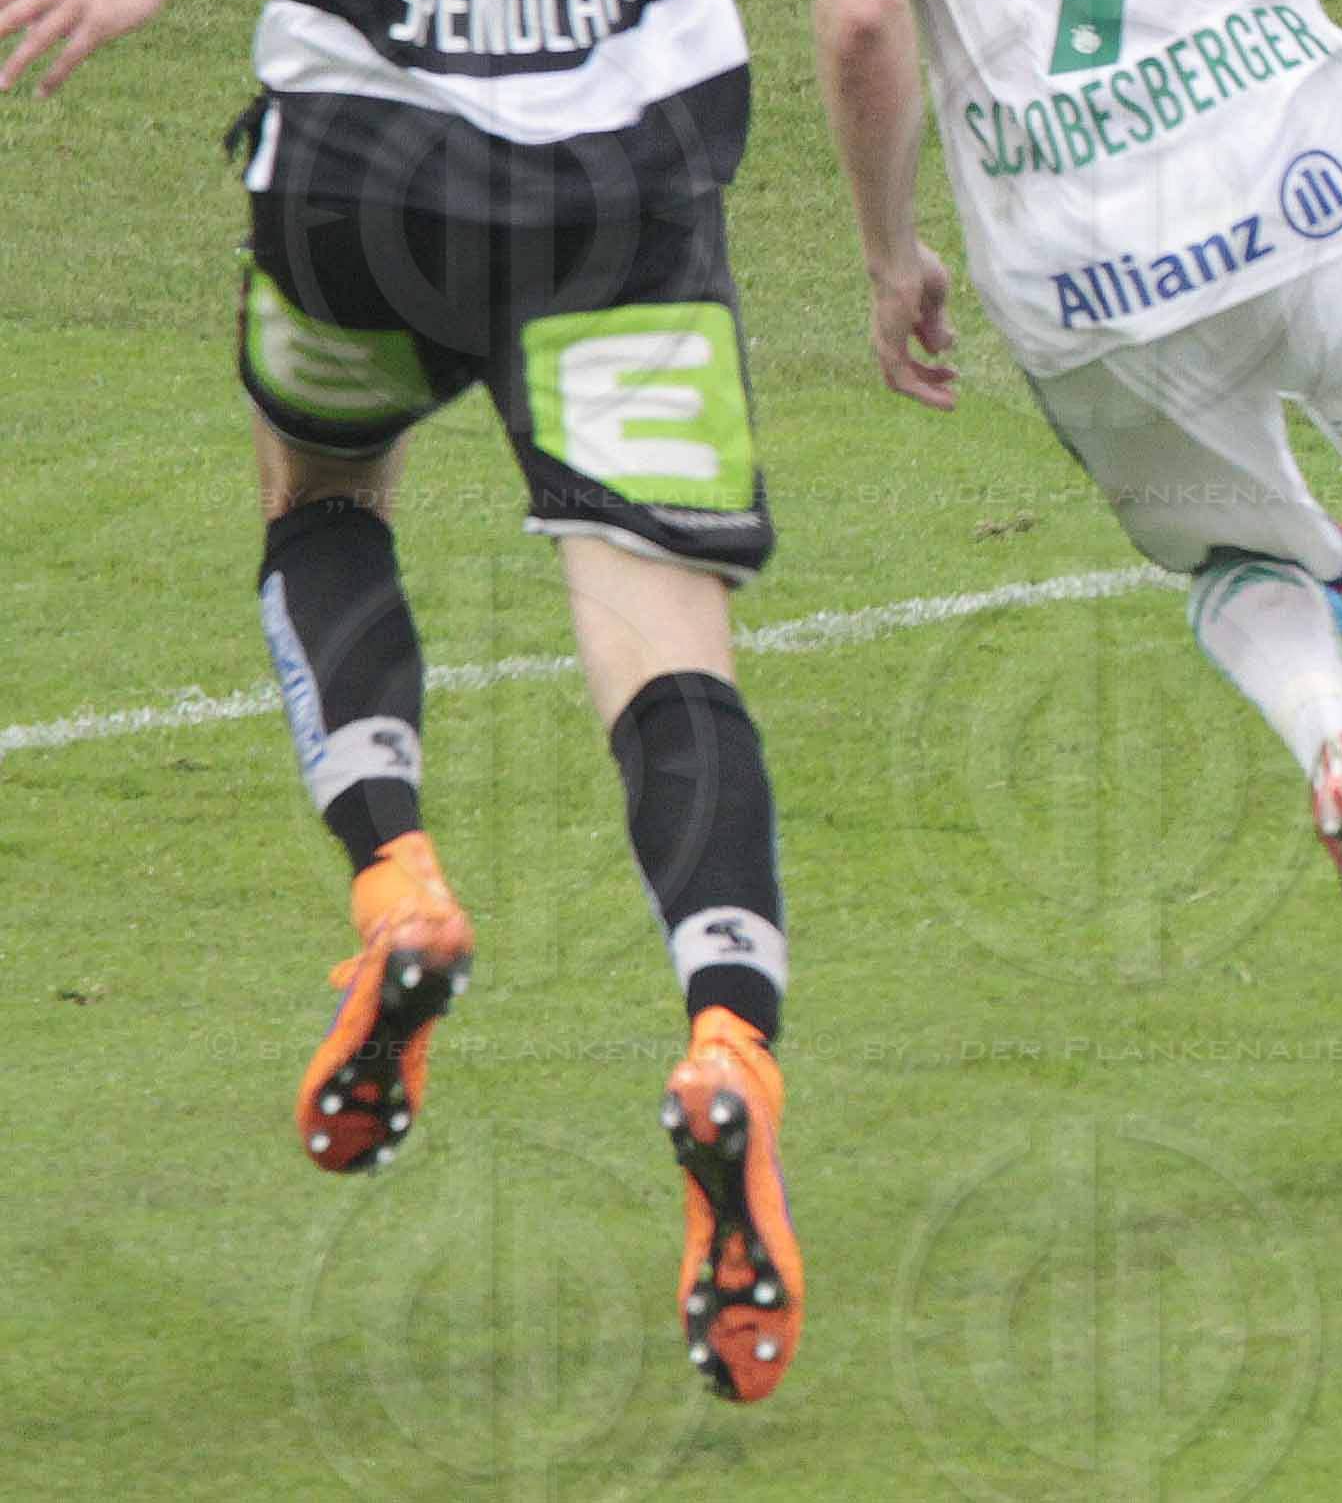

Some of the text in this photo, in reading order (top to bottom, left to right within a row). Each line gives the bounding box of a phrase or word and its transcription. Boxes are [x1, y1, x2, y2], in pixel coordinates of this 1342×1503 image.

[965, 3, 1331, 177] SCOBESBERGER
[1050, 214, 1276, 330] Allianz
[559, 331, 720, 482] E
